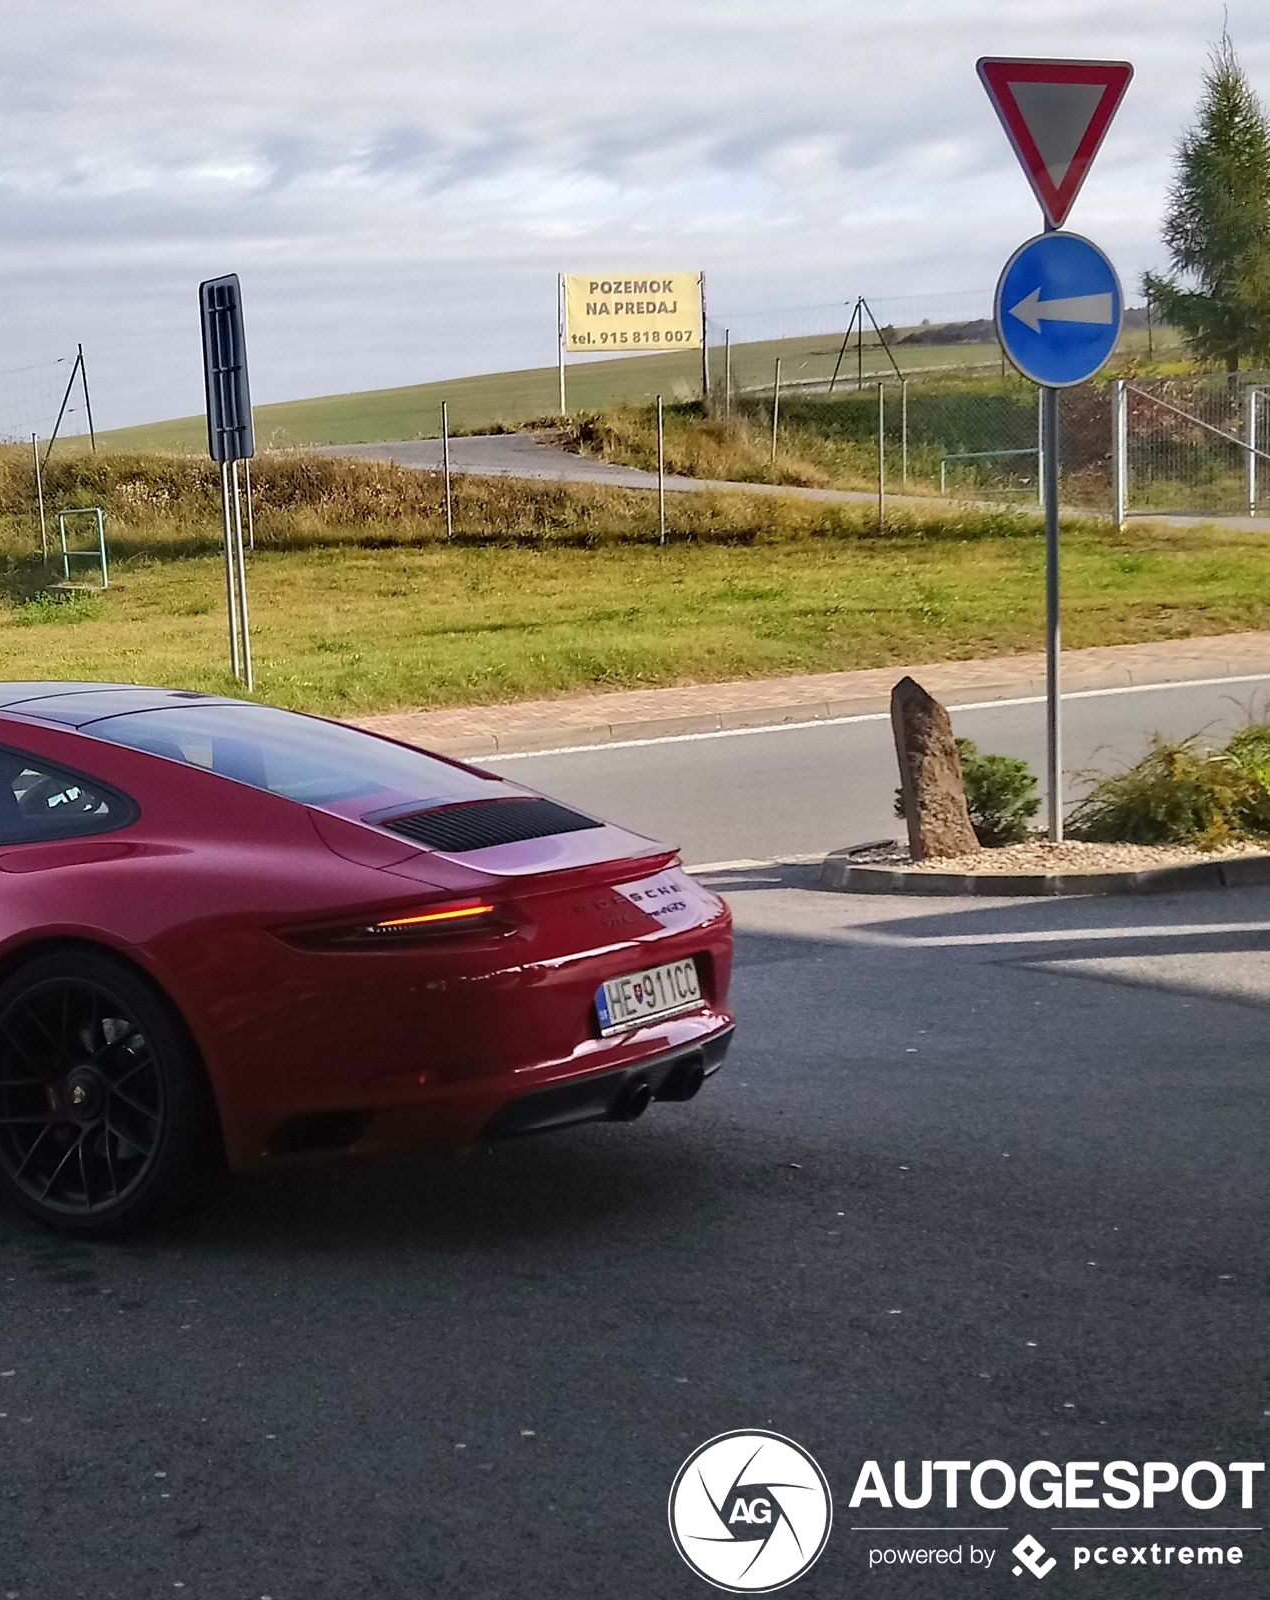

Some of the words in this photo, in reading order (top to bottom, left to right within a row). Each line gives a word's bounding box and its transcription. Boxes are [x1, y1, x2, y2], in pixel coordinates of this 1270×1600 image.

[589, 280, 674, 295] POZEMOK
[586, 302, 610, 316] NA
[614, 301, 677, 315] PREDAJ
[571, 332, 596, 345] tel.
[600, 332, 628, 344] 915
[632, 331, 660, 343] 818
[665, 330, 693, 342] 007
